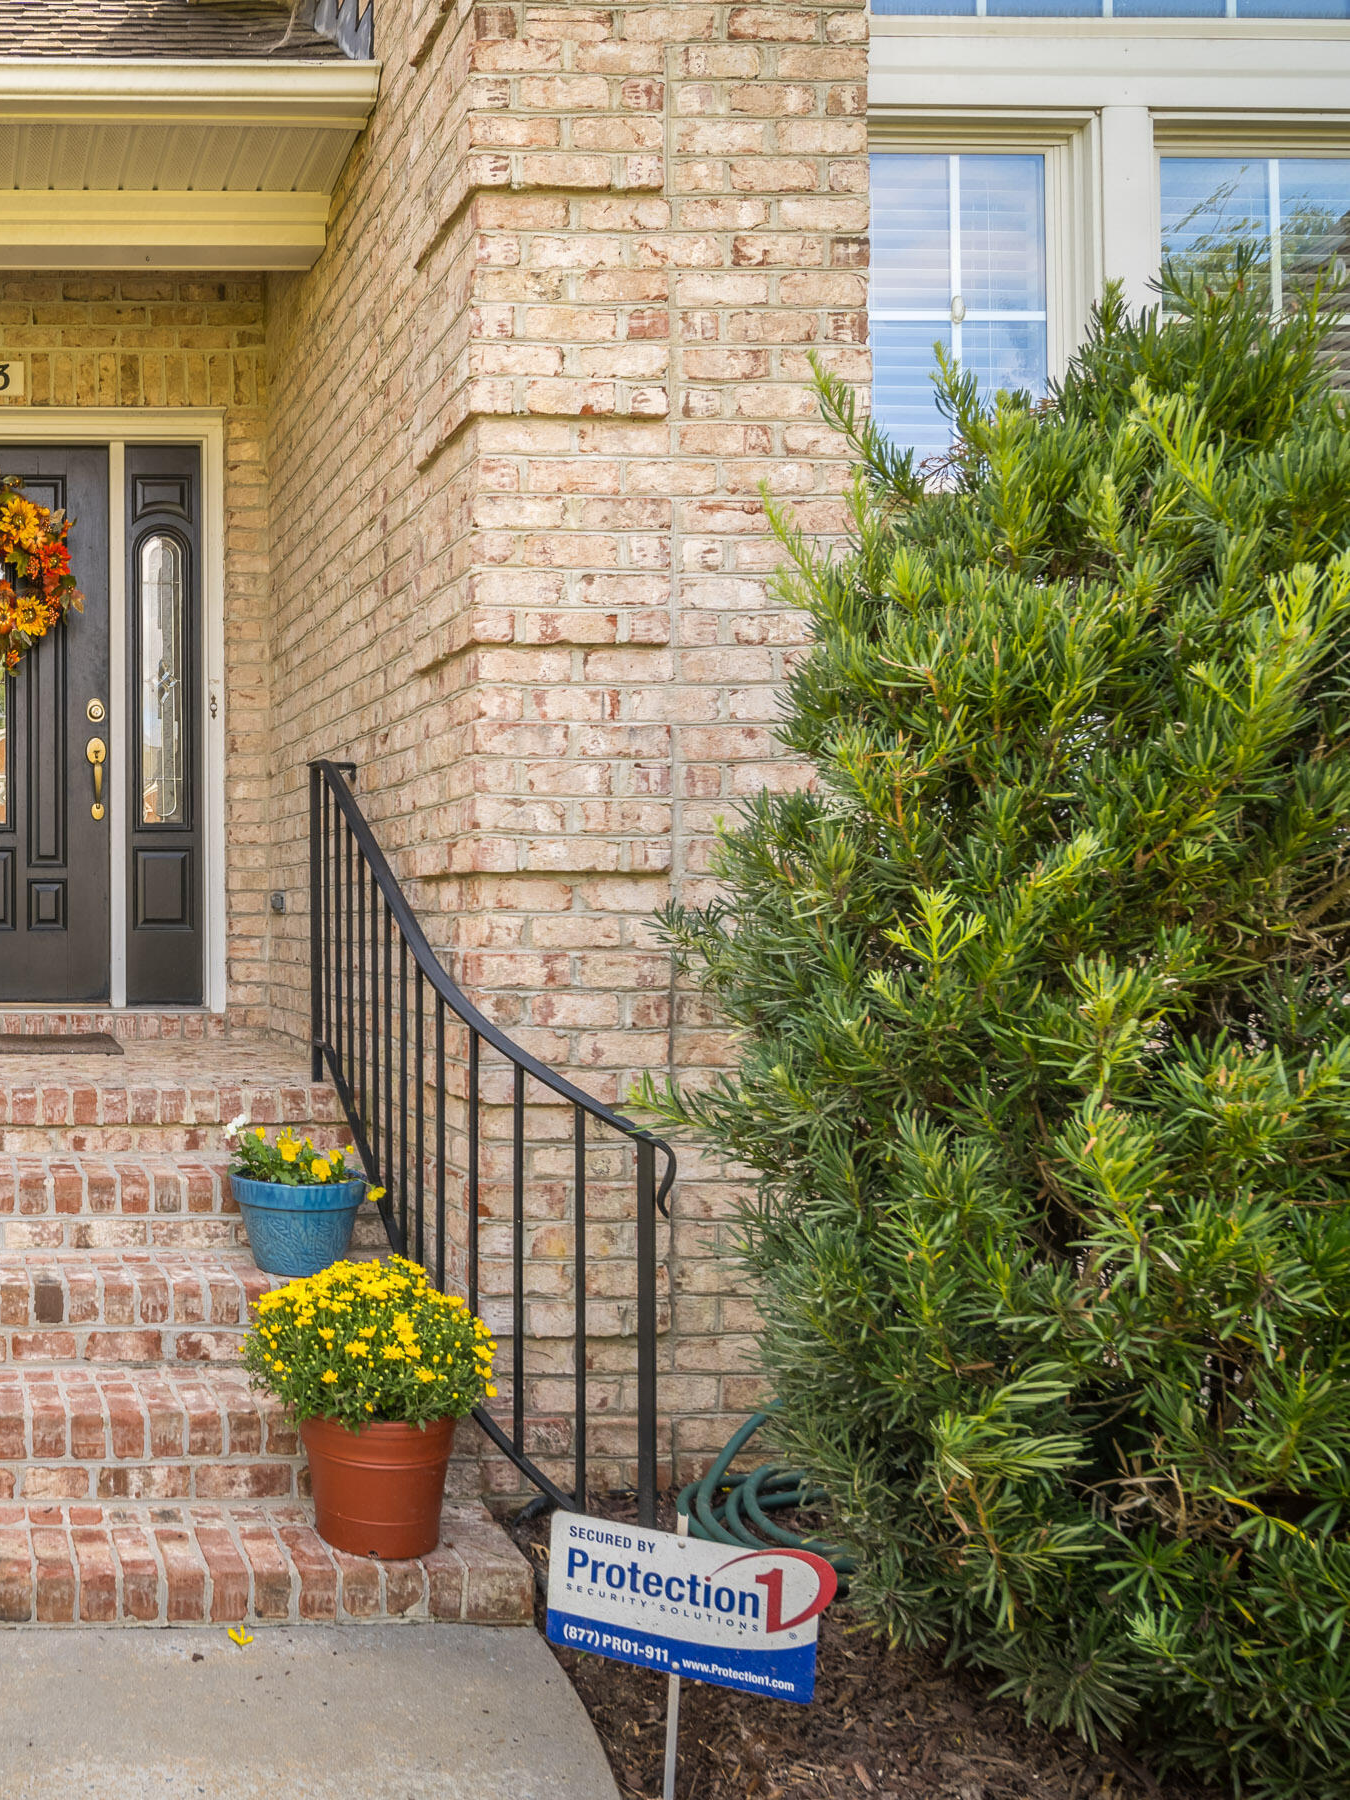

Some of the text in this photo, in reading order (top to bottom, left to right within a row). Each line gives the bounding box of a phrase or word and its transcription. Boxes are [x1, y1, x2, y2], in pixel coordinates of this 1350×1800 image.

[569, 1525, 656, 1554] SECURED BY
[566, 1583, 759, 1632] SECURITY SOLUTIONS
[563, 1623, 600, 1647] (877)
[682, 1658, 795, 1692] www.Protection1.com
